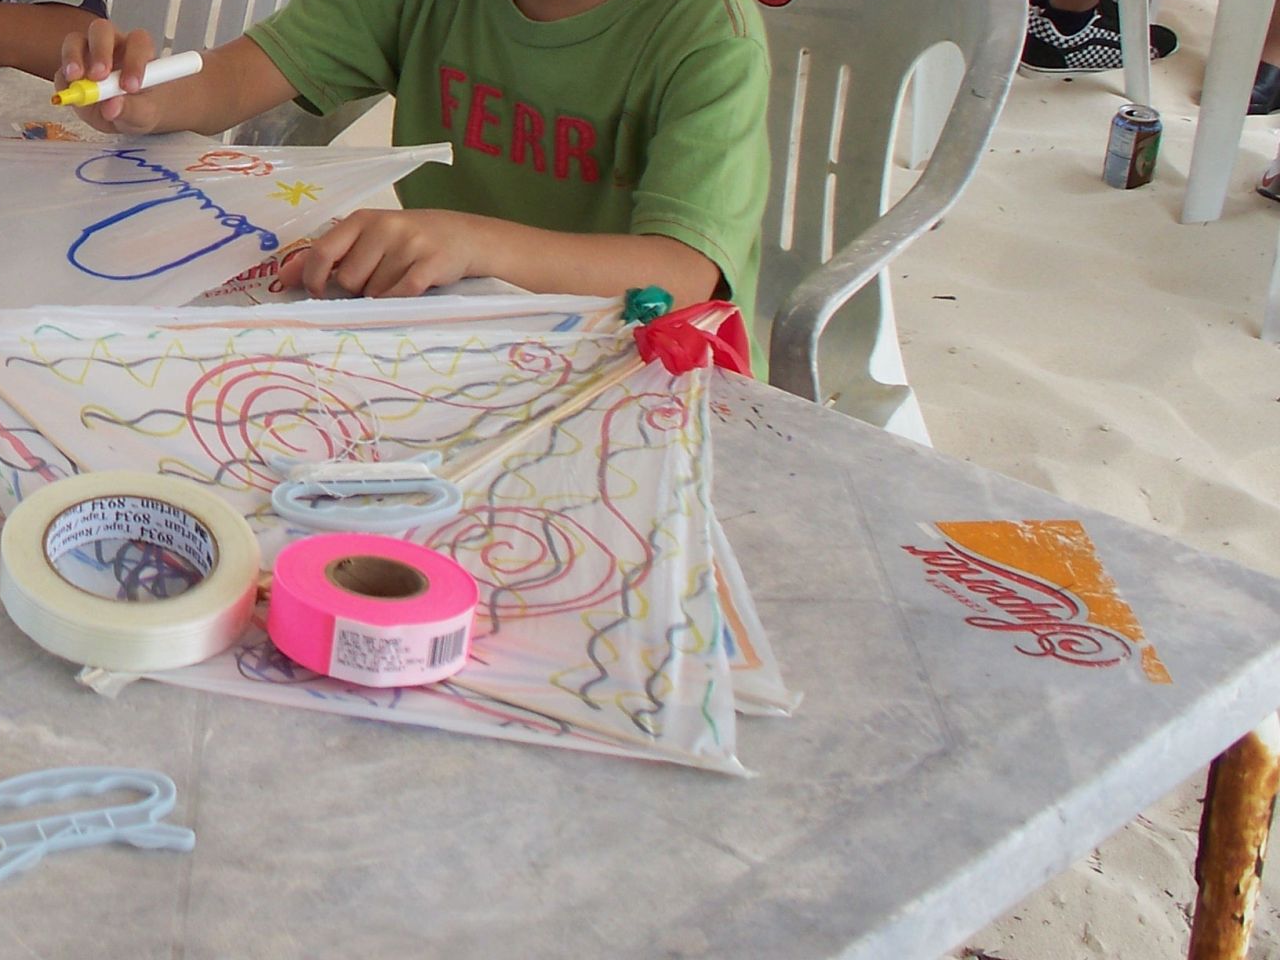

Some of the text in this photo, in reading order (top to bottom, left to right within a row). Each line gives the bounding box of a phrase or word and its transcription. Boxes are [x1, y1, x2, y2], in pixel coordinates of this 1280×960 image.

[115, 509, 151, 525] 8934
[102, 522, 131, 534] Tape
[140, 526, 174, 545] 8934
[900, 541, 1133, 668] Superior
